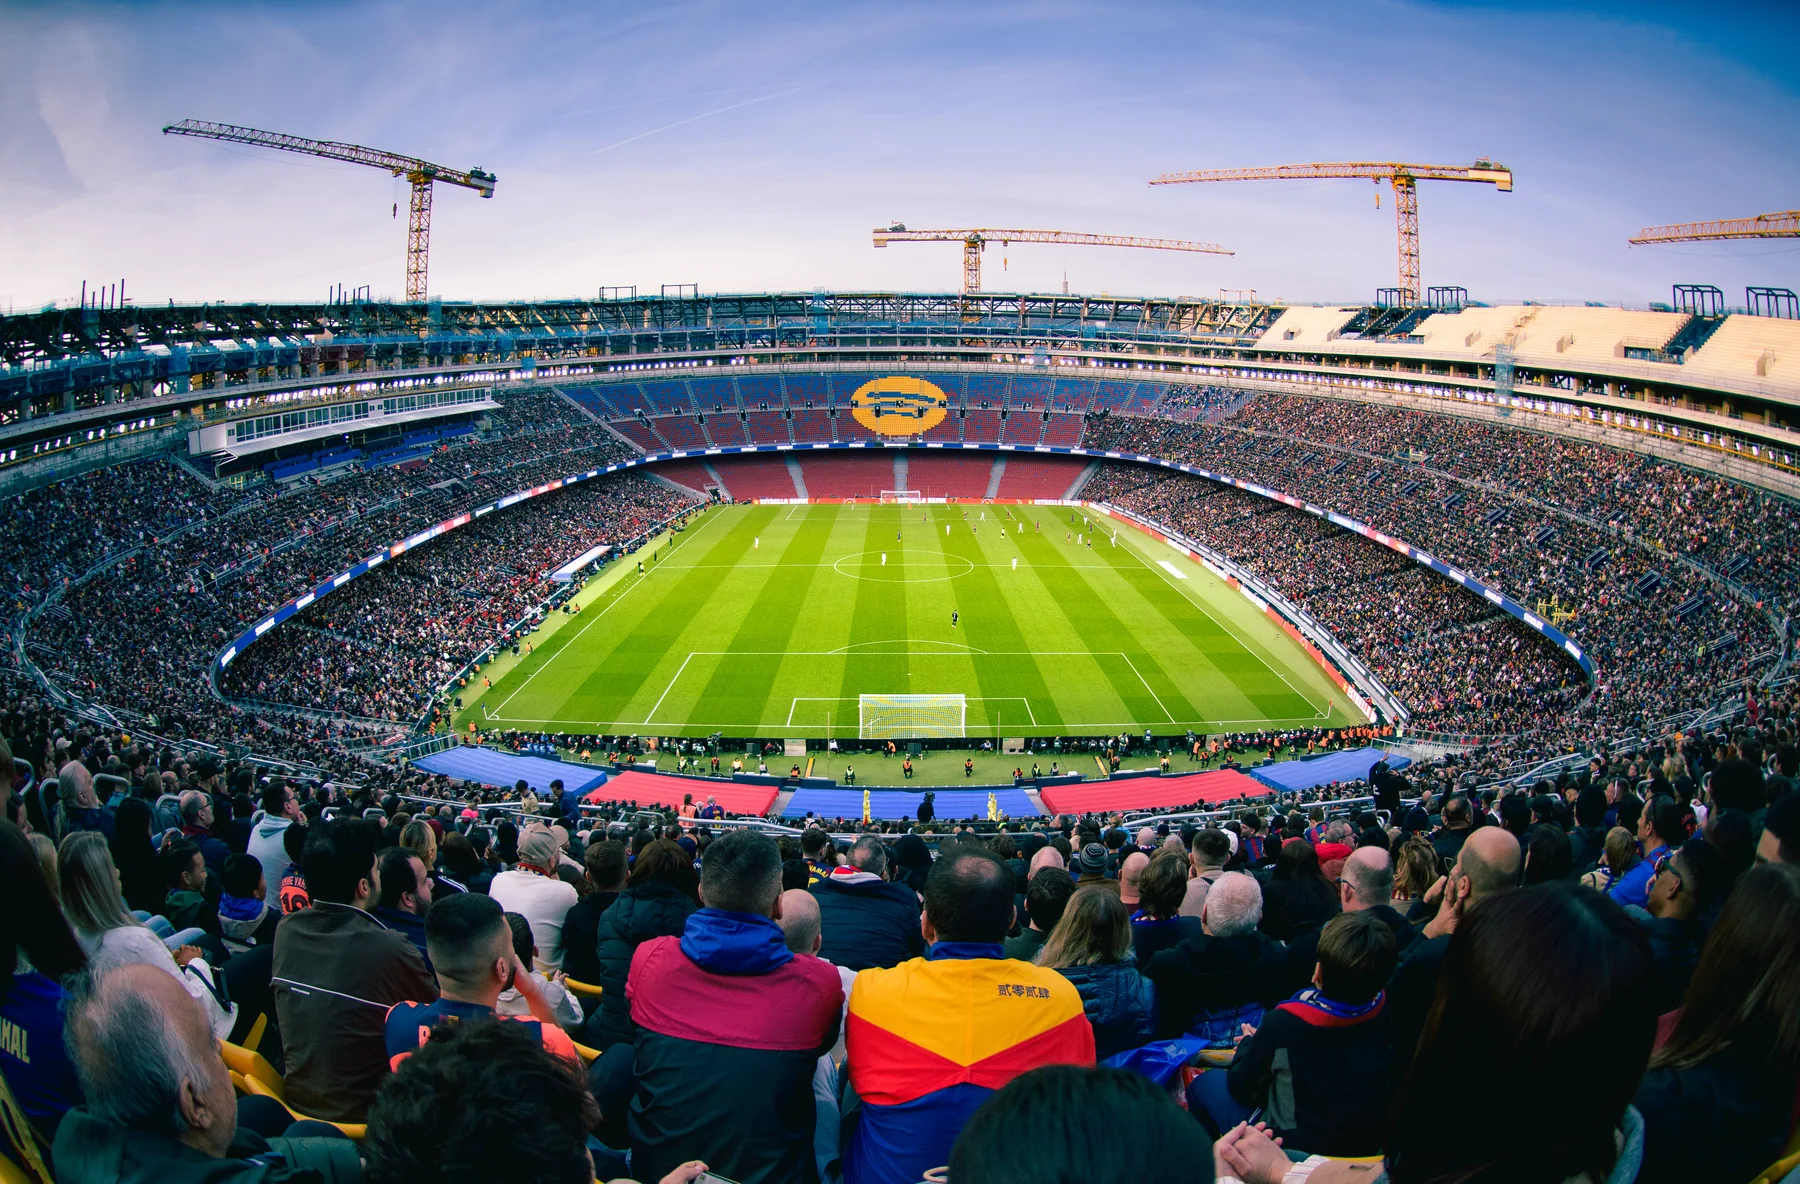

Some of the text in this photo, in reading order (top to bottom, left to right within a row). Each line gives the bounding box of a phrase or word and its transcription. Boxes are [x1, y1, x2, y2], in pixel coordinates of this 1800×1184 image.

[997, 984, 1051, 999] 贰零贰肆
[0, 1015, 31, 1064] MAL
